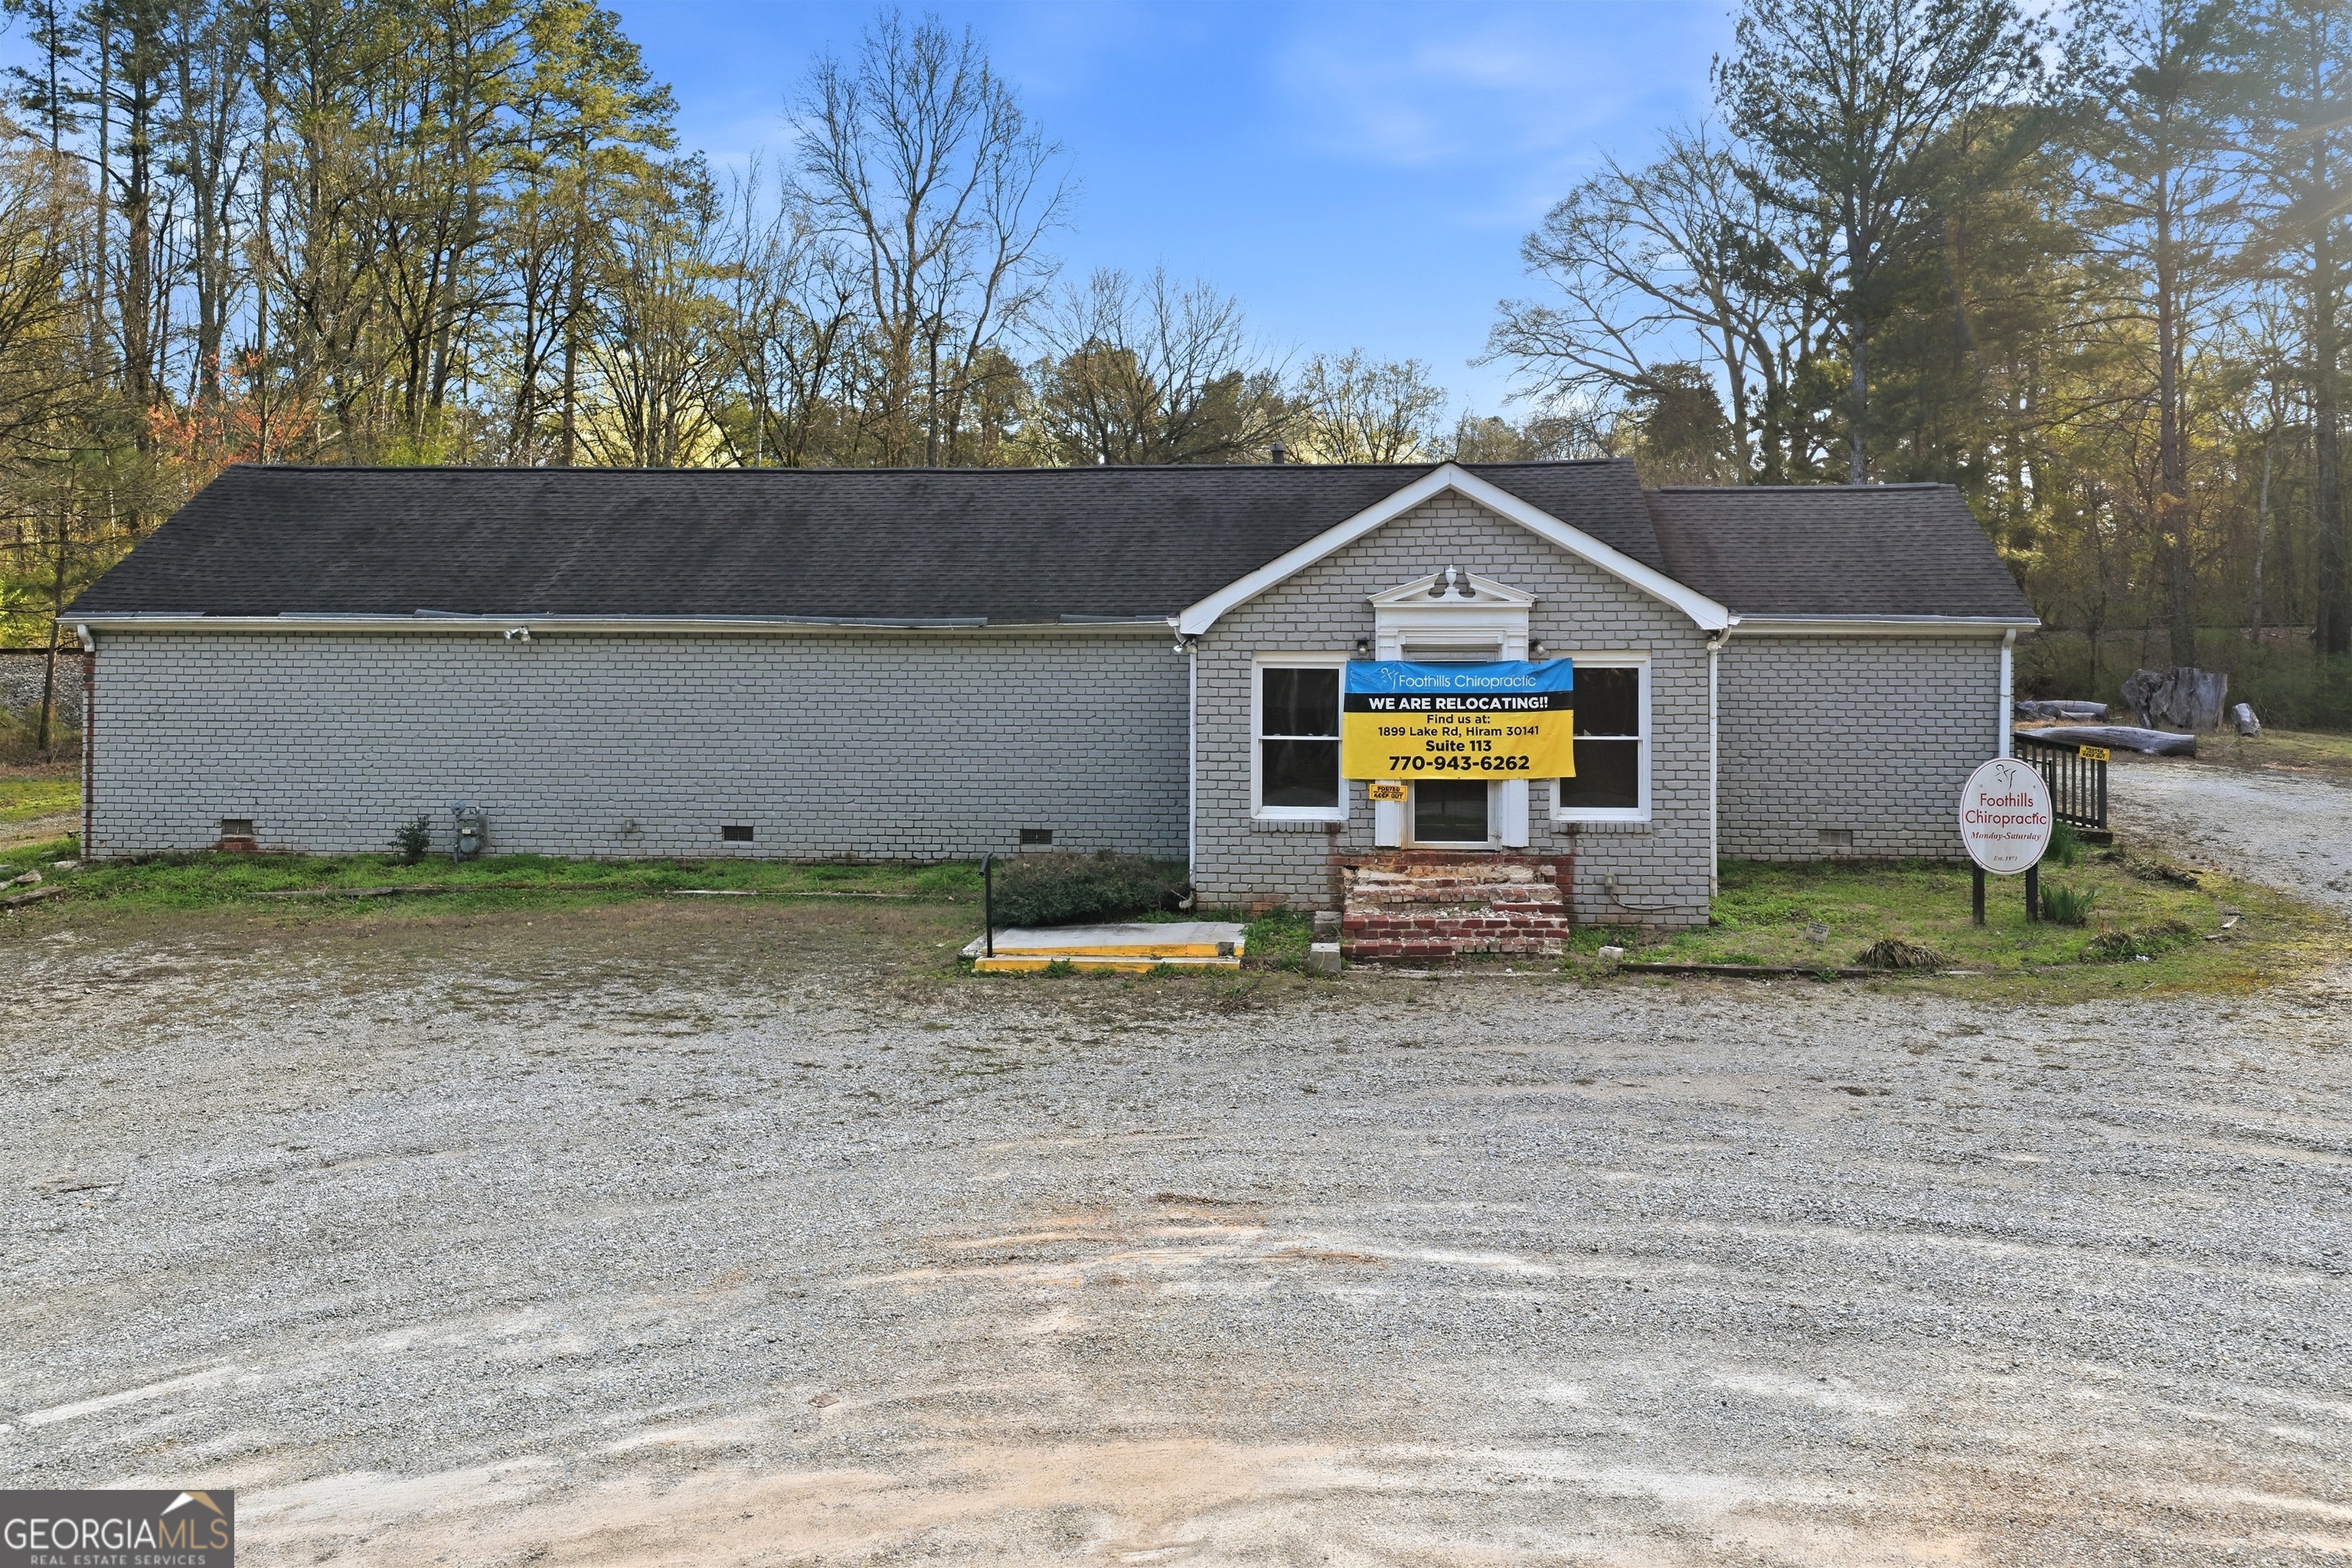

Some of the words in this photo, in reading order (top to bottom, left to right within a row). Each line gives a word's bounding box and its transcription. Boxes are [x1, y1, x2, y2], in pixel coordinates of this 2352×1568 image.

[1399, 675, 1451, 688] Foothills
[1454, 675, 1537, 689] Chiropractic
[1369, 697, 1395, 710] WE
[1399, 697, 1433, 710] ARE
[1436, 696, 1548, 710] RELOCATING!!
[1426, 714, 1454, 724] Find
[1475, 714, 1491, 724] at:
[1378, 727, 1406, 736] 1899
[1410, 727, 1438, 736] Lake
[1442, 726, 1462, 737] Rd,
[1466, 726, 1502, 736] Hiram
[1506, 725, 1539, 736] 30141
[1426, 740, 1465, 752] Suite
[1469, 740, 1492, 752] 113
[1389, 755, 1530, 771] 770-943-6262
[1980, 792, 2034, 807] Foothills
[1965, 810, 2047, 828] Chiropractic
[1971, 831, 2042, 841] Monday-Saturday
